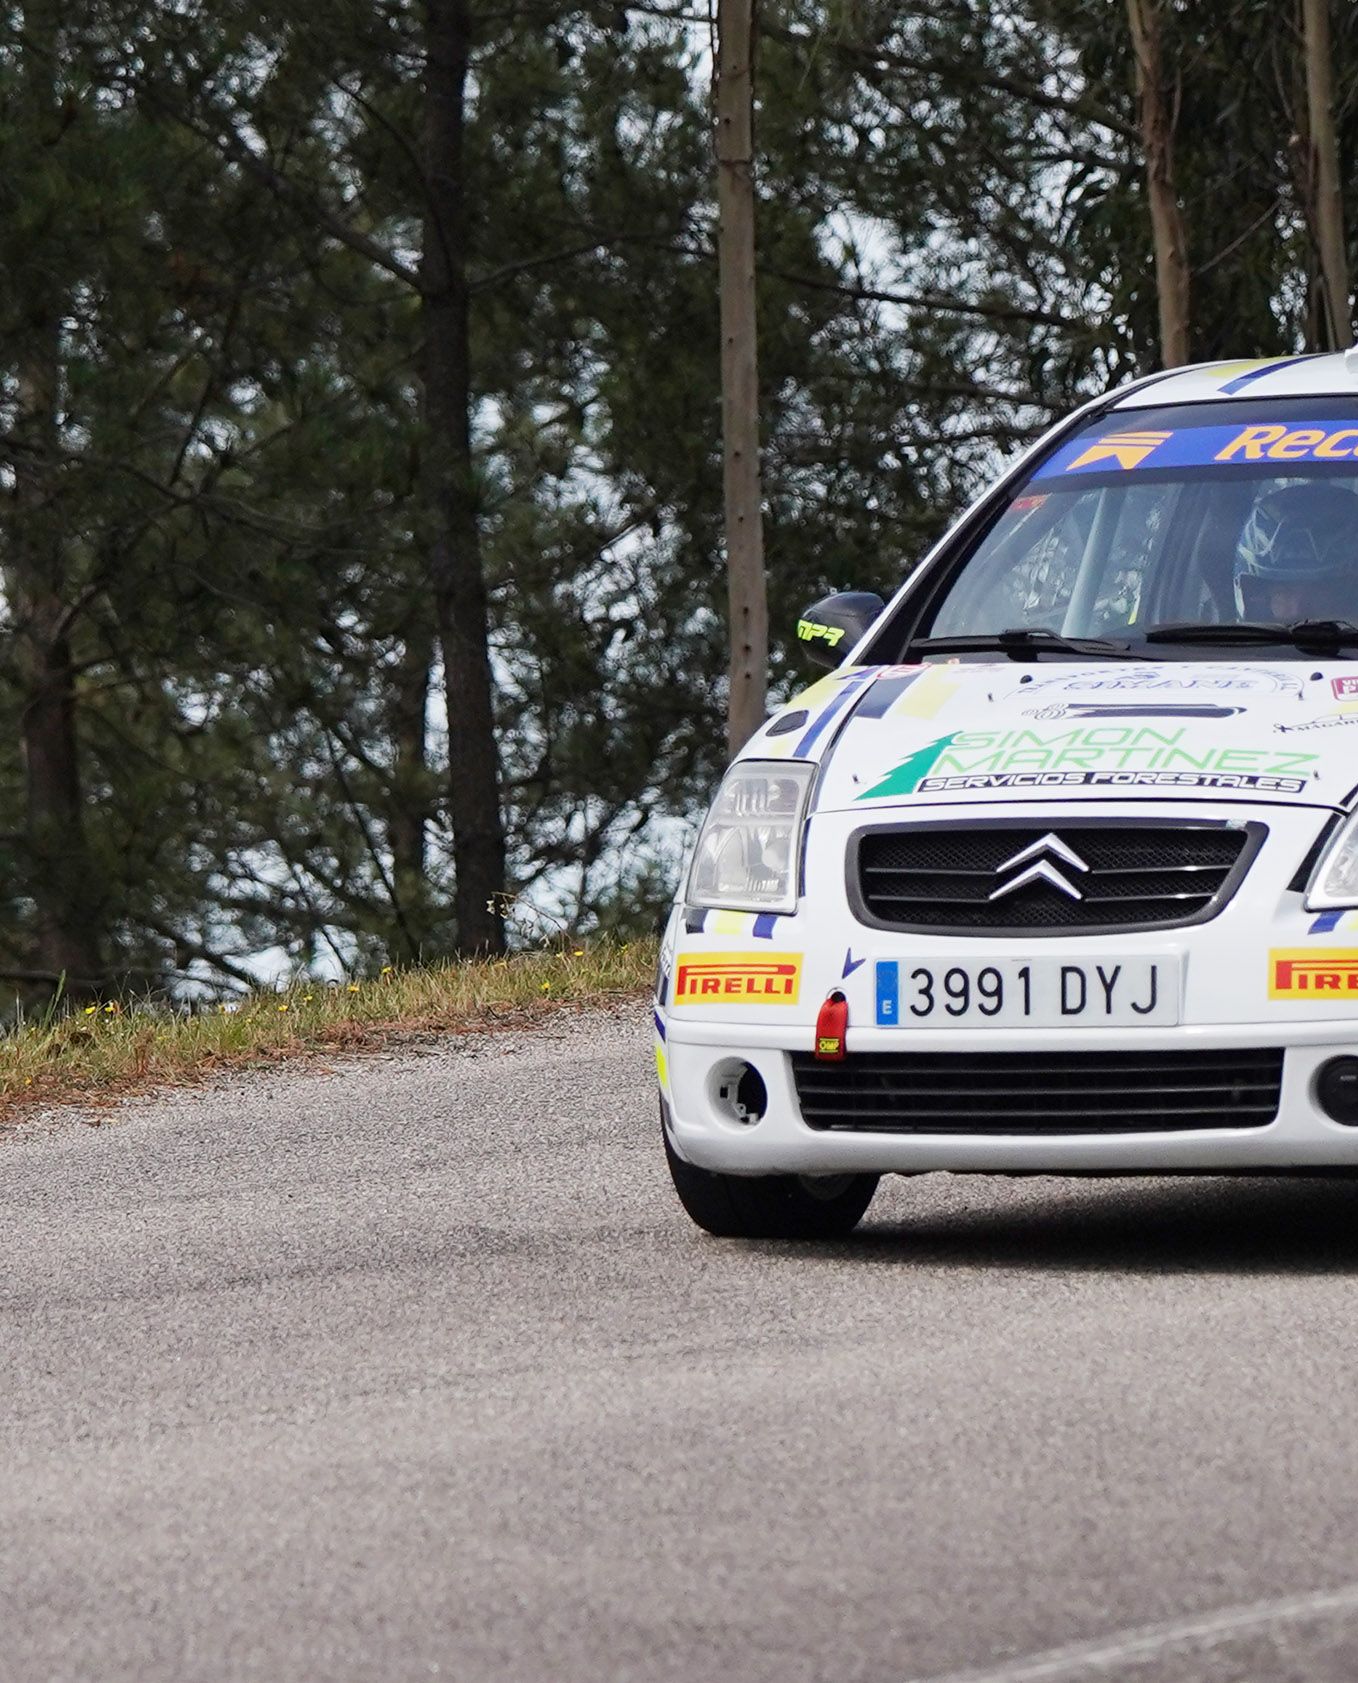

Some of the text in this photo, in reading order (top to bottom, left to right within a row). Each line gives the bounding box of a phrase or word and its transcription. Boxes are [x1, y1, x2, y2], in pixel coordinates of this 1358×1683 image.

[948, 727, 1187, 749] SIMON
[932, 747, 1320, 776] MARTINEZ
[923, 771, 1304, 793] SERVICIOS FORESTALES
[677, 963, 797, 996] PIRELLI
[882, 965, 1157, 1017] E 3991 DYJ
[819, 1040, 840, 1050] OMP
